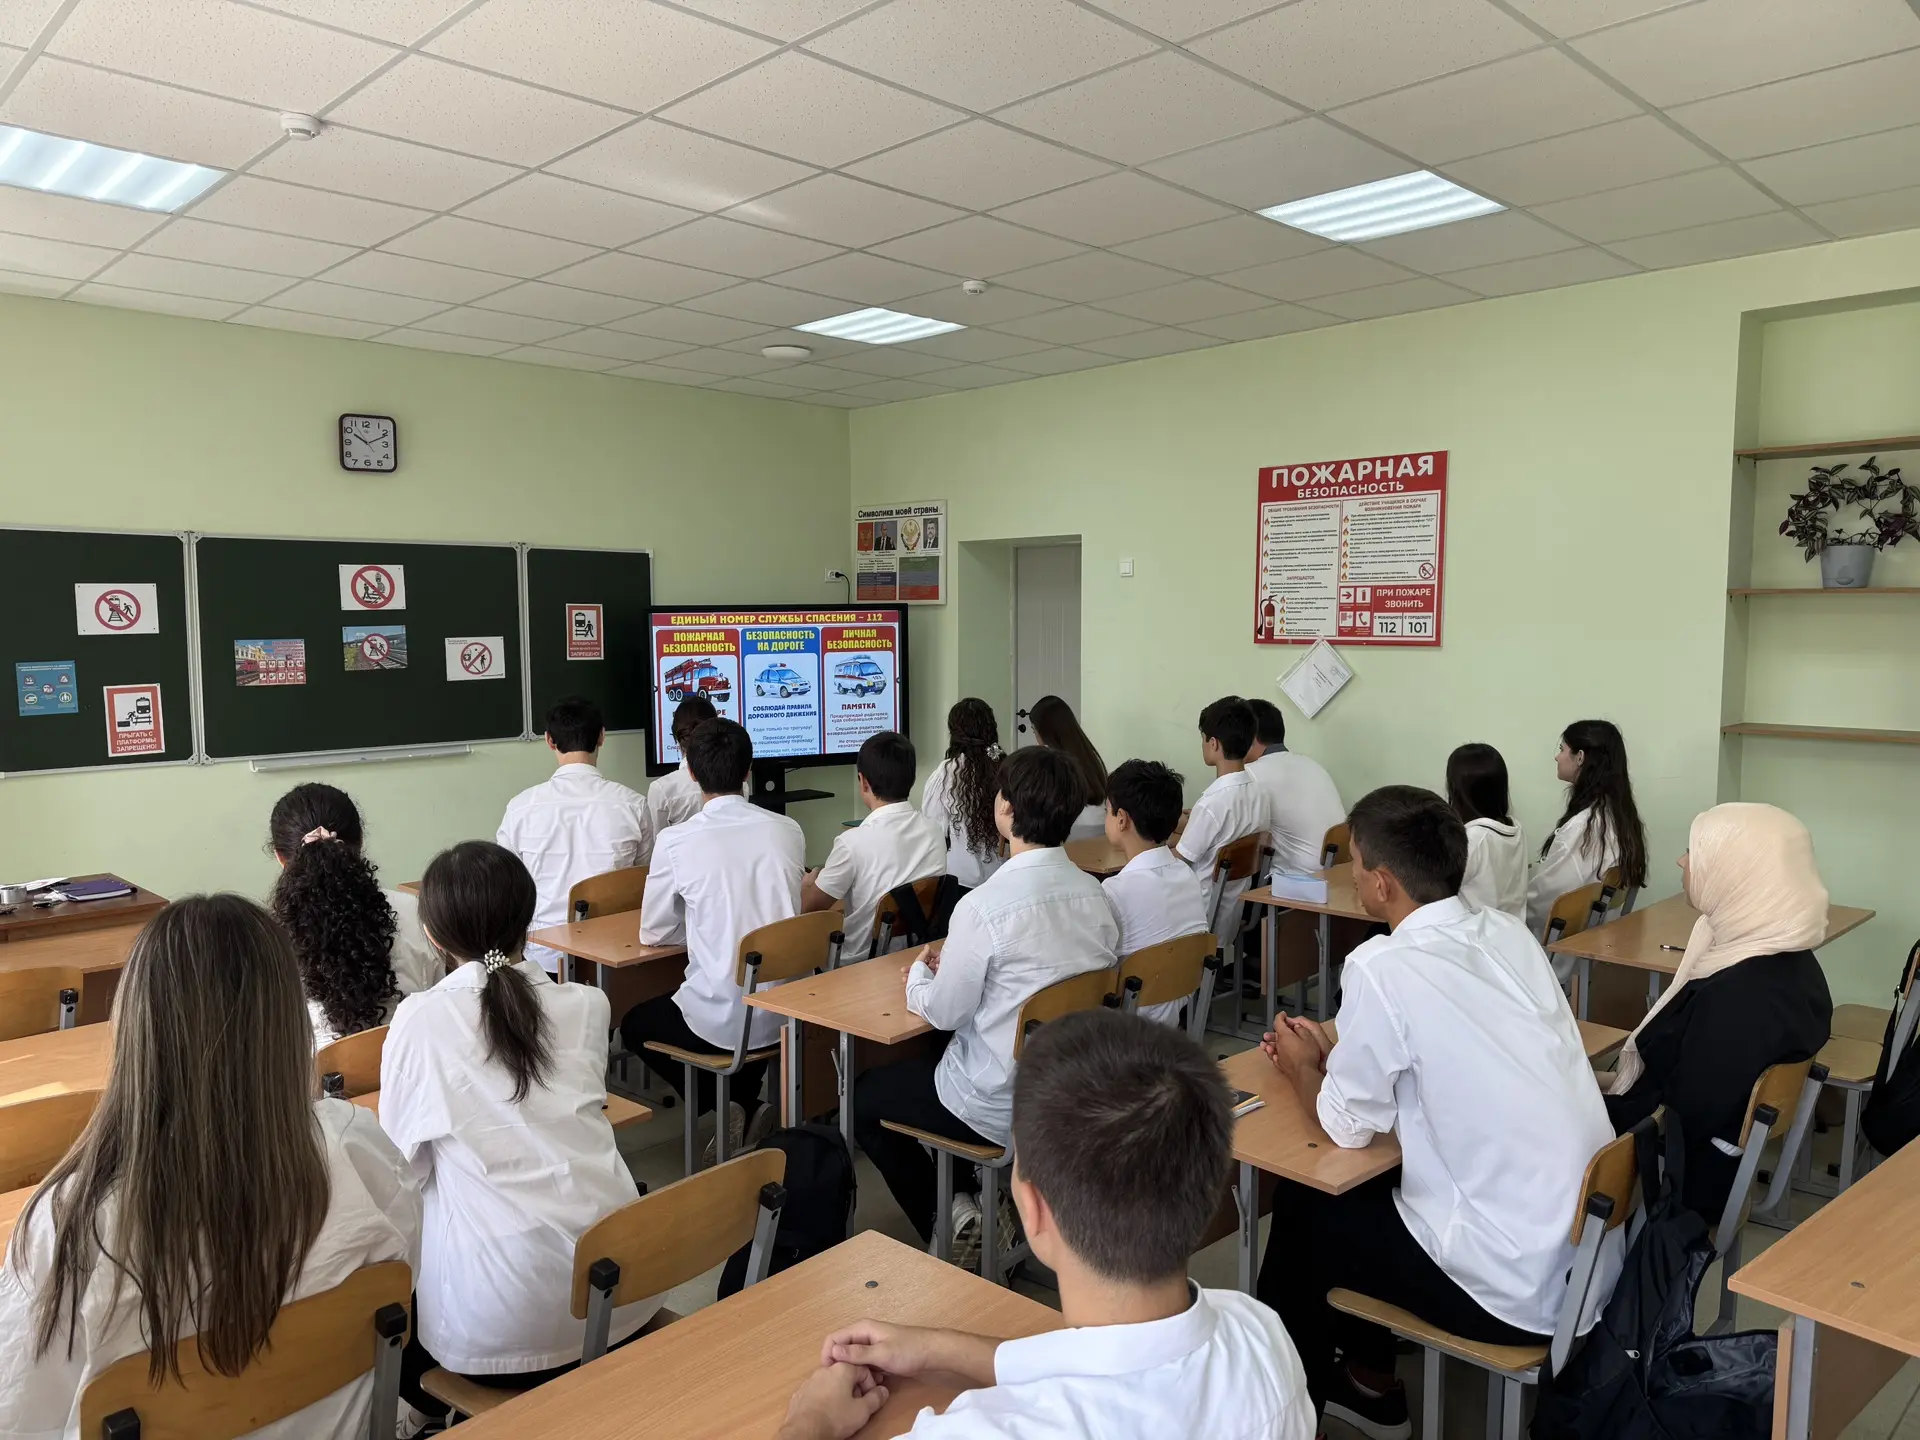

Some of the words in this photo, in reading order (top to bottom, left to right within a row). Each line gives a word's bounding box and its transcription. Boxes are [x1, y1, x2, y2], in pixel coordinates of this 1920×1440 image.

[344, 426, 353, 434] 10
[344, 438, 352, 446] 9
[1272, 455, 1434, 488] ПОЖАРНАЯ
[1297, 482, 1404, 498] БЕЗОПАСНОСТЬ
[858, 509, 894, 518] Символика
[895, 507, 911, 515] моей
[914, 506, 938, 514] страны
[1396, 588, 1431, 596] ПОЖАРЕ
[1385, 600, 1424, 608] ЗВОНИТЬ
[671, 613, 716, 625] ЕДИНЫЙ
[720, 615, 756, 624] НОМЕР
[758, 615, 803, 623] СЛУЖБЫ
[806, 614, 856, 622] СПАСЕНИЯ
[1379, 622, 1396, 633] 112
[1408, 622, 1427, 633] 101
[674, 632, 725, 642] ПОЖАРНАЯ
[746, 630, 815, 640] БЕЗОПАСНОСТЬ
[843, 629, 877, 638] ЛИЧНАЯ
[663, 643, 736, 653] БЕЗОПАСНОСТЬ
[758, 642, 769, 650] НА
[771, 641, 805, 652] ДОРОГЕ
[827, 639, 892, 650] БЕЗОПАСНОСТЬ
[753, 704, 785, 712] СОБЛЮДАЙ
[117, 744, 157, 752] ЗАПРЕЩЕНО!
